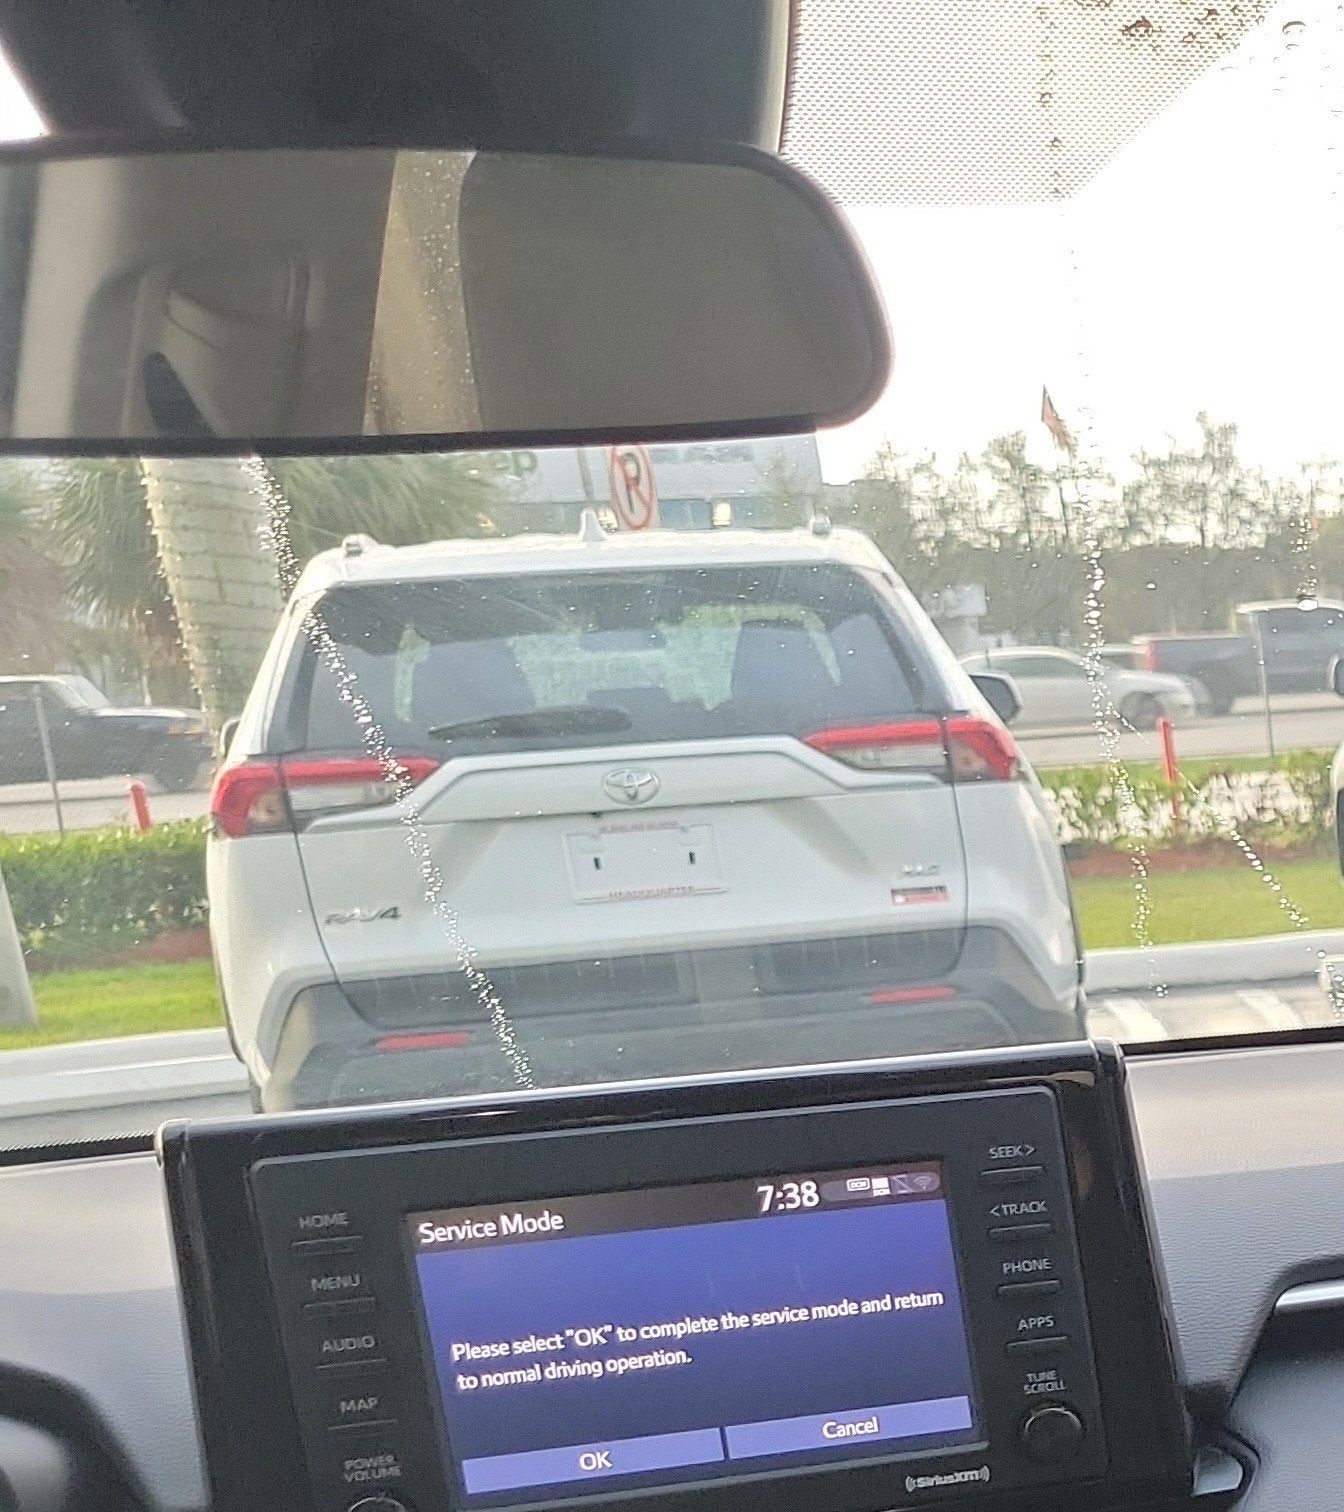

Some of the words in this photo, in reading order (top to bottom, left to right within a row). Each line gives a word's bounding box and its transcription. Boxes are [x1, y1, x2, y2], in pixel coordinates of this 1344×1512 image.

[757, 1180, 820, 1212] 7:38
[300, 1212, 349, 1229] HOME
[418, 1219, 498, 1245] Service
[500, 1210, 565, 1236] Mode
[1002, 1258, 1053, 1275] PHONE
[310, 1273, 361, 1292] MENU
[452, 1341, 510, 1362] Please
[512, 1333, 565, 1355] select
[565, 1324, 613, 1347] "OK"
[616, 1325, 637, 1342] to
[640, 1313, 719, 1341] complete
[720, 1311, 750, 1330] the
[751, 1307, 810, 1327] service
[811, 1298, 860, 1320] mode
[861, 1293, 892, 1314] and
[894, 1291, 944, 1310] return
[1017, 1315, 1055, 1331] APPS
[322, 1334, 376, 1353] AUDIO
[457, 1373, 479, 1391] to
[481, 1363, 542, 1388] normal
[544, 1358, 604, 1379] driving
[605, 1349, 693, 1375] operation.
[1026, 1370, 1058, 1384] TUNE
[1022, 1379, 1067, 1395] SCROLL
[339, 1396, 379, 1413] MAP
[822, 1416, 879, 1440] Cancel
[344, 1454, 395, 1471] POWER
[579, 1449, 613, 1472] OK
[343, 1466, 401, 1483] VOLUME
